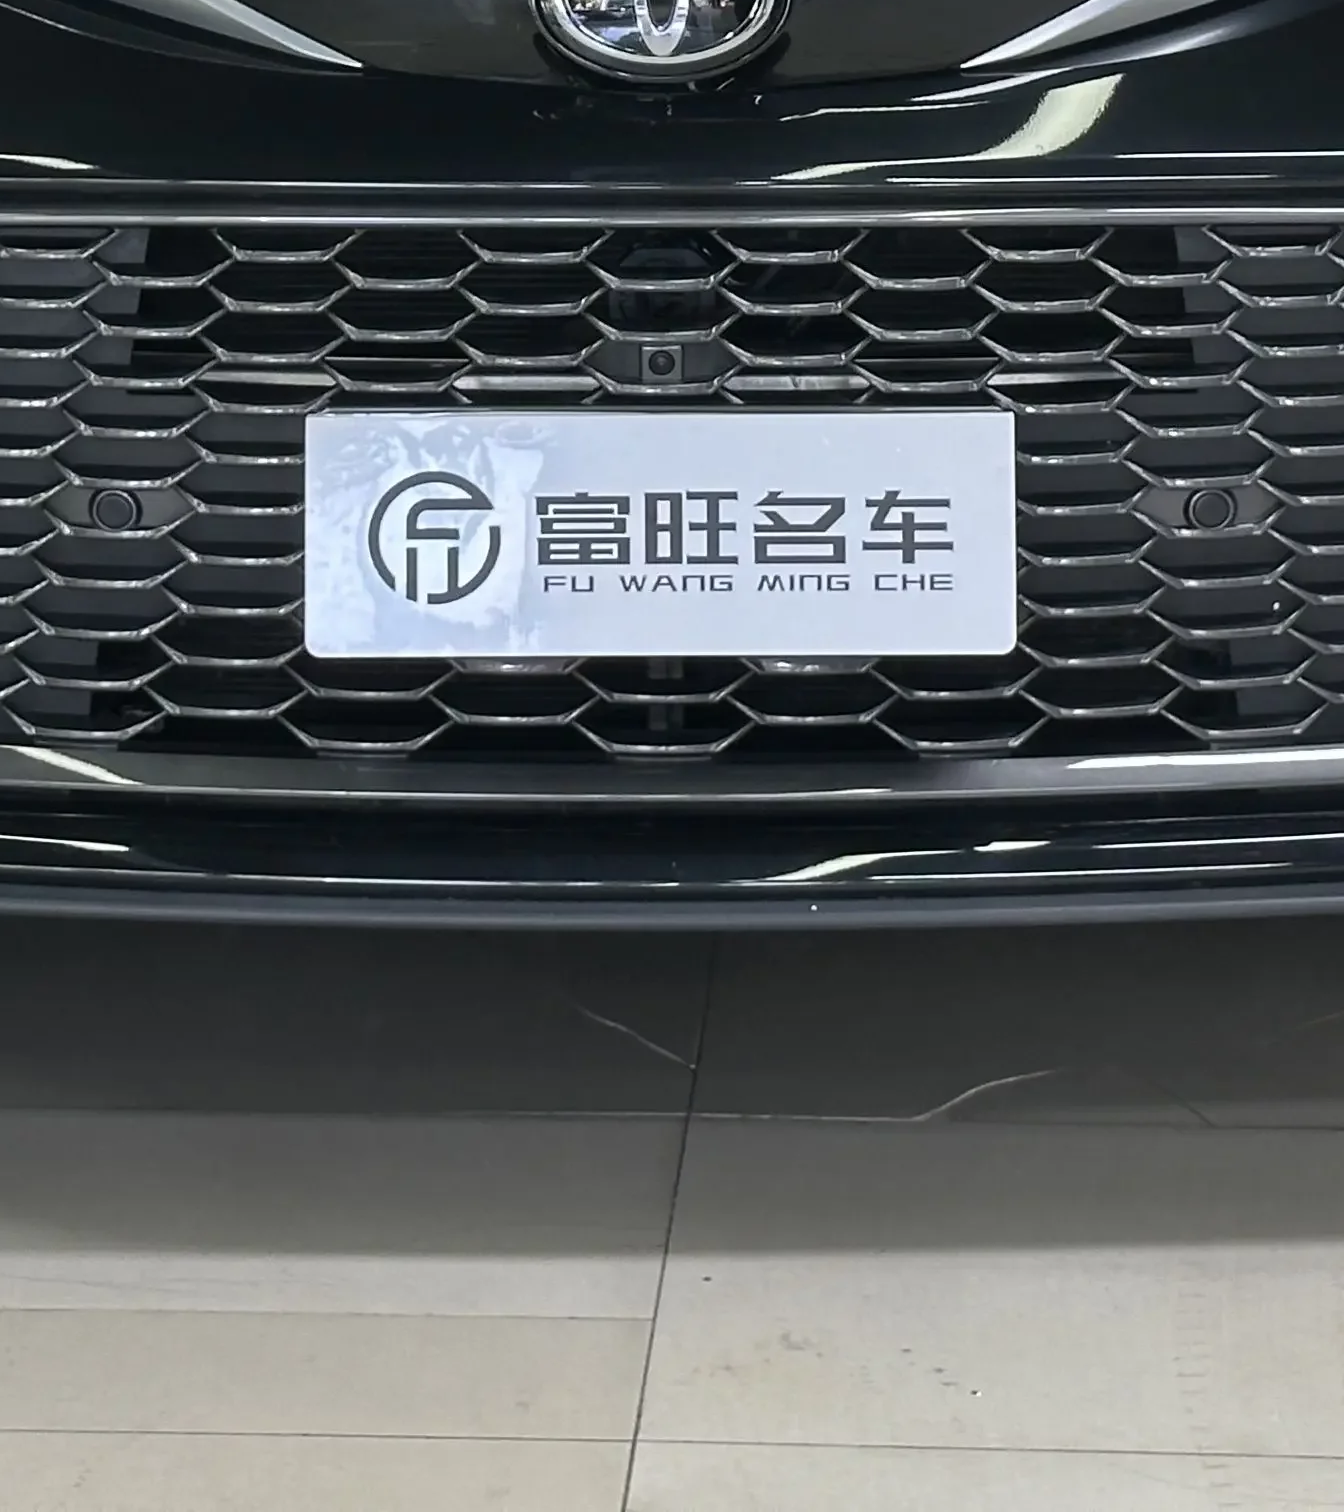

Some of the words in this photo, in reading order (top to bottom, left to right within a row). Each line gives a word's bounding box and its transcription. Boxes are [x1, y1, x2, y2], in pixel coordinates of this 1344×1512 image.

[536, 490, 954, 565] 富旺名车
[544, 575, 594, 592] FU
[620, 575, 733, 592] WANG
[757, 574, 851, 591] MING
[874, 574, 953, 591] CHE
